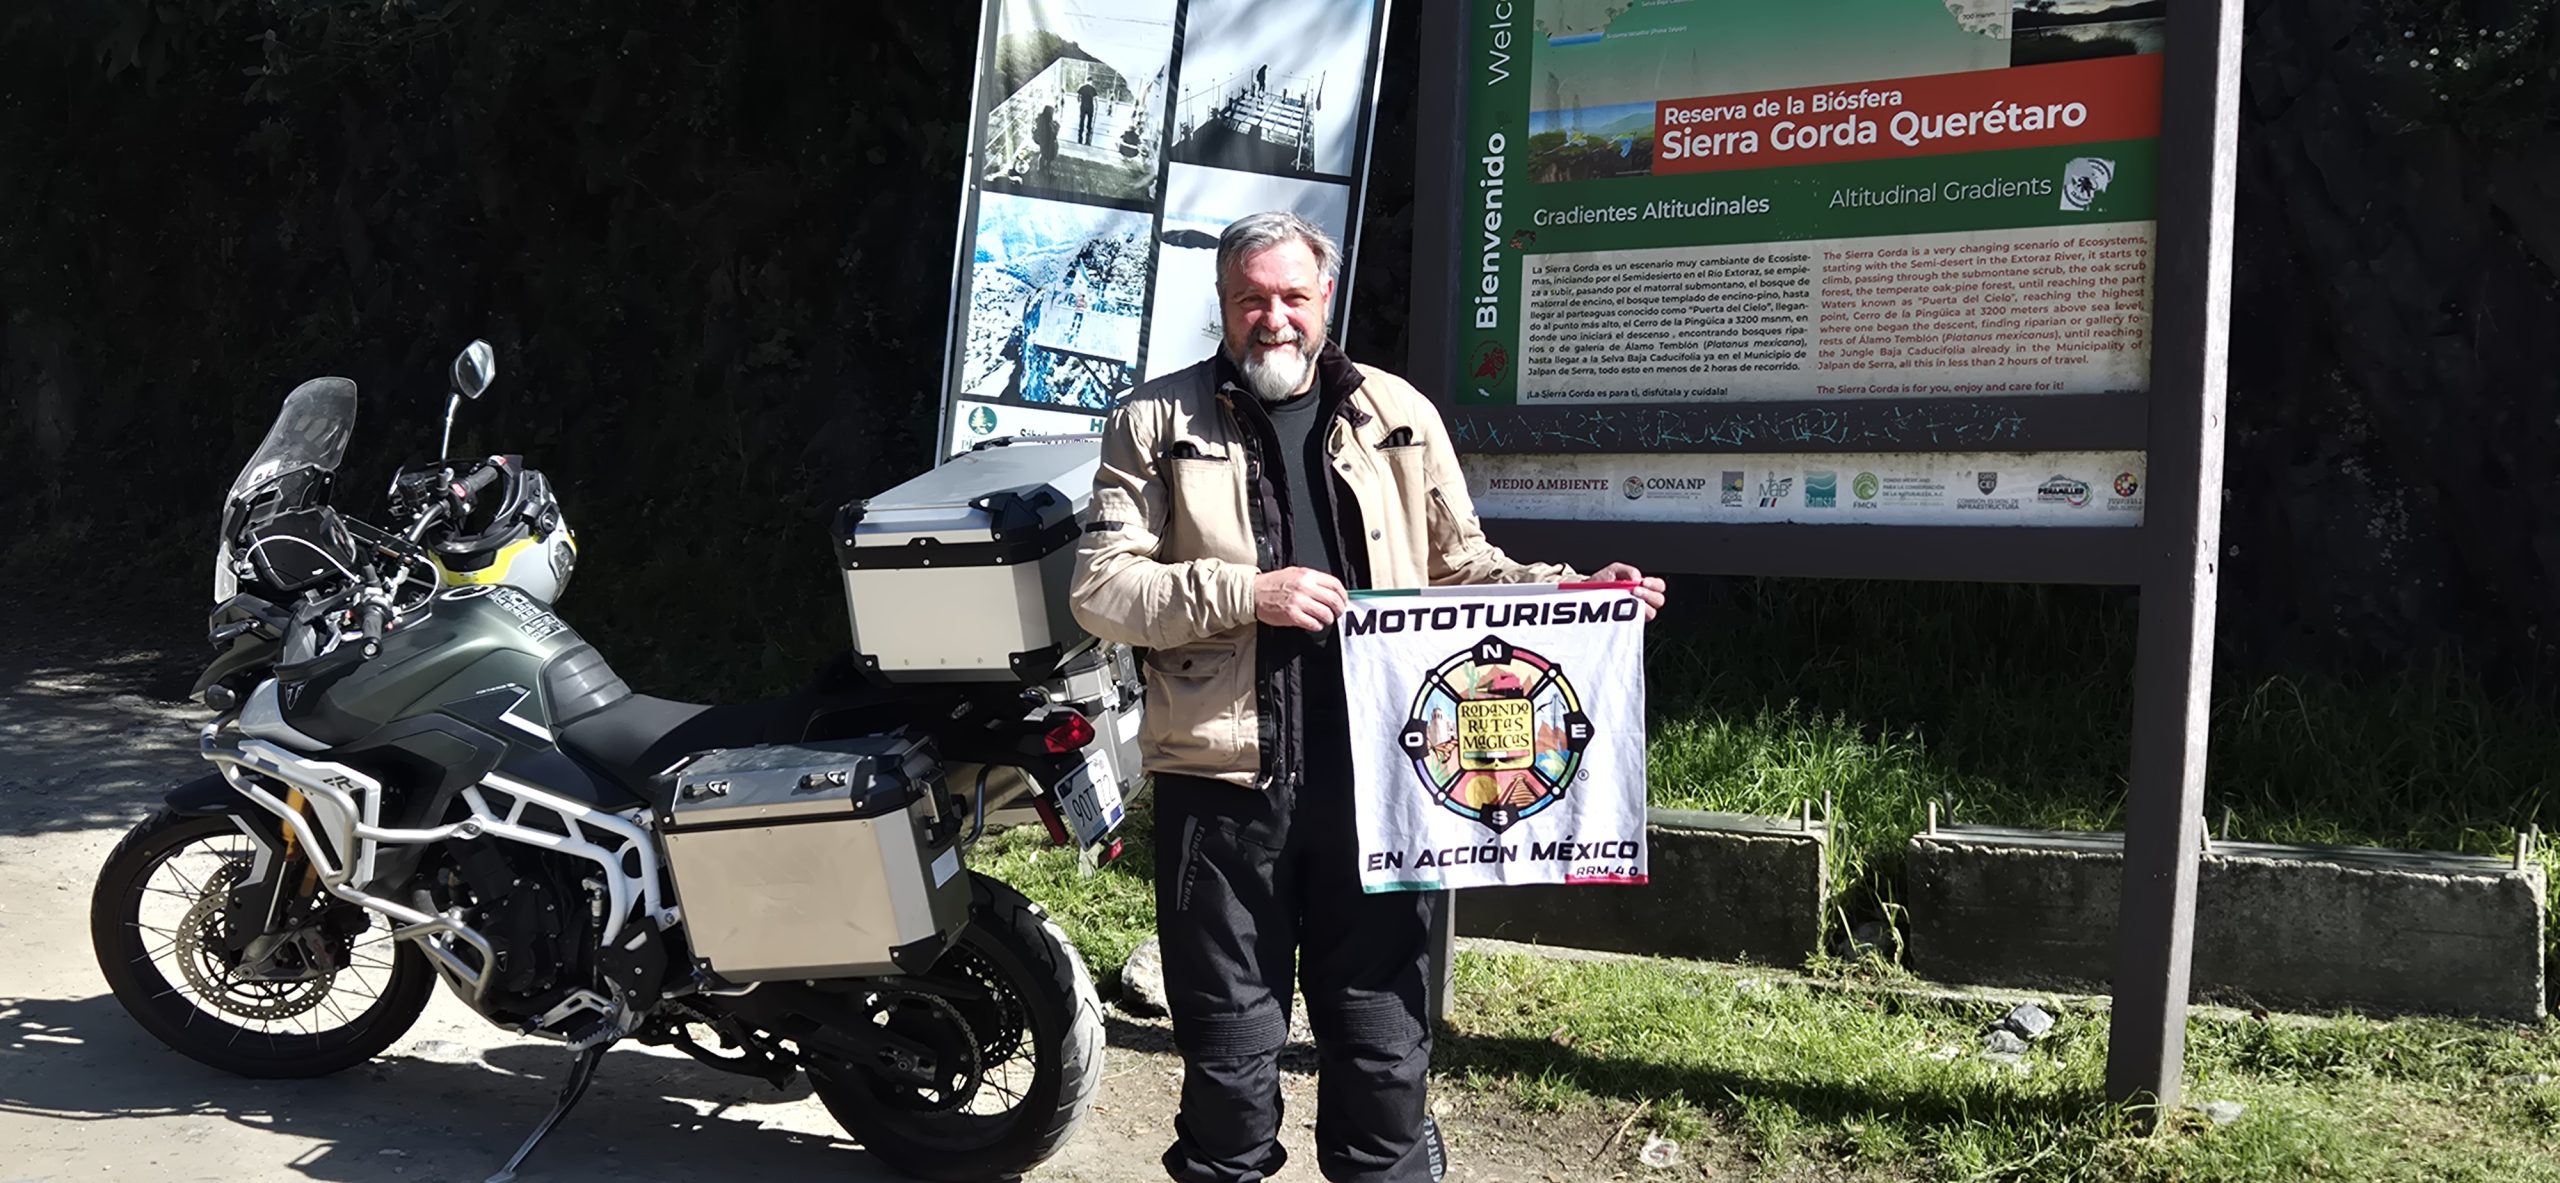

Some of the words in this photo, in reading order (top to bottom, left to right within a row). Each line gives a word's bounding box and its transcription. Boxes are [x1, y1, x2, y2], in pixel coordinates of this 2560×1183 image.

[1664, 103, 1747, 125] Reserva
[1753, 98, 1780, 119] de
[1786, 95, 1805, 115] la
[1812, 87, 1903, 113] Biósfera
[1663, 127, 1758, 159] Sierra
[1771, 115, 1876, 150] Gorda
[1890, 101, 2086, 146] Querétaro
[1829, 182, 1937, 208] Altitudinal
[1943, 177, 2052, 201] Gradients
[1533, 205, 1637, 226] Gradientes
[1642, 195, 1770, 220] Altitudinales
[1475, 133, 1505, 327] Bienvenido
[1824, 250, 1842, 260] The
[1844, 249, 1874, 259] Sierra
[1876, 247, 1908, 257] Gorda
[1910, 246, 1920, 255] is
[1932, 246, 1956, 256] very
[1958, 242, 2010, 254] changing
[2014, 239, 2060, 250] scenario
[2062, 238, 2075, 247] of
[1532, 265, 1543, 274] La
[1544, 264, 1571, 273] Sierra
[1572, 262, 1600, 272] Gorda
[1628, 259, 1674, 269] escenario
[1676, 260, 1698, 269] muy
[1698, 255, 1750, 266] cambiante
[1752, 254, 1765, 263] de
[1854, 273, 1894, 285] passing
[1896, 270, 1939, 283] through
[1940, 269, 1959, 279] the
[1962, 266, 2030, 278] submontane
[2068, 263, 2087, 273] the
[2090, 262, 2111, 272] oak
[2114, 261, 2147, 271] scrub
[1530, 298, 1568, 308] matorral
[1568, 297, 1581, 306] de
[1616, 296, 1625, 304] el
[1626, 294, 1660, 306] bosque
[1660, 292, 1706, 304] templado
[1706, 292, 1720, 301] de
[1782, 289, 1809, 298] hasta
[1530, 321, 1541, 330] do
[1542, 321, 1551, 330] al
[1552, 320, 1579, 331] punto
[1580, 319, 1600, 329] más
[1622, 318, 1632, 327] el
[1632, 318, 1658, 327] Cerro
[1660, 317, 1672, 326] de
[1674, 317, 1682, 325] la
[1734, 314, 1759, 323] 3200
[1528, 366, 1556, 377] Jalpan
[1558, 366, 1570, 375] de
[1598, 365, 1620, 374] todo
[1620, 364, 1641, 373] esto
[1688, 363, 1702, 372] de
[1702, 363, 1709, 372] 2
[1710, 363, 1738, 371] horas
[1738, 362, 1752, 371] de
[1818, 360, 1850, 371] Jalpan
[1852, 360, 1866, 368] de
[1898, 359, 1911, 367] all
[1914, 358, 1933, 367] this
[1936, 358, 1946, 366] in
[1948, 357, 1969, 366] less
[1970, 357, 1996, 366] than
[1998, 356, 2005, 365] 2
[2006, 356, 2038, 365] hours
[2040, 355, 2052, 364] of
[1540, 389, 1567, 397] Sierra
[1568, 388, 1595, 397] Gorda
[1608, 390, 1629, 398] para
[1682, 389, 1690, 397] y
[1816, 385, 1835, 393] The
[1836, 384, 1867, 393] Sierra
[1868, 384, 1899, 392] Gorda
[1900, 383, 1910, 392] is
[1912, 383, 1928, 392] for
[1952, 384, 1983, 393] enjoy
[1984, 382, 2006, 390] and
[2034, 381, 2050, 390] for
[2052, 381, 2064, 389] it!
[1489, 478, 1534, 490] MEDIO
[1536, 479, 1609, 491] AMBIENTE
[1646, 477, 1706, 490] CONANP
[1852, 501, 1878, 509] FMCN
[1482, 644, 1502, 659] N
[1405, 731, 1424, 747] O
[1571, 724, 1587, 739] E
[1492, 810, 1508, 825] S
[1367, 850, 1404, 873] EN
[1414, 838, 1518, 869] ACCIÓN
[1530, 835, 1639, 862] MÉXICO
